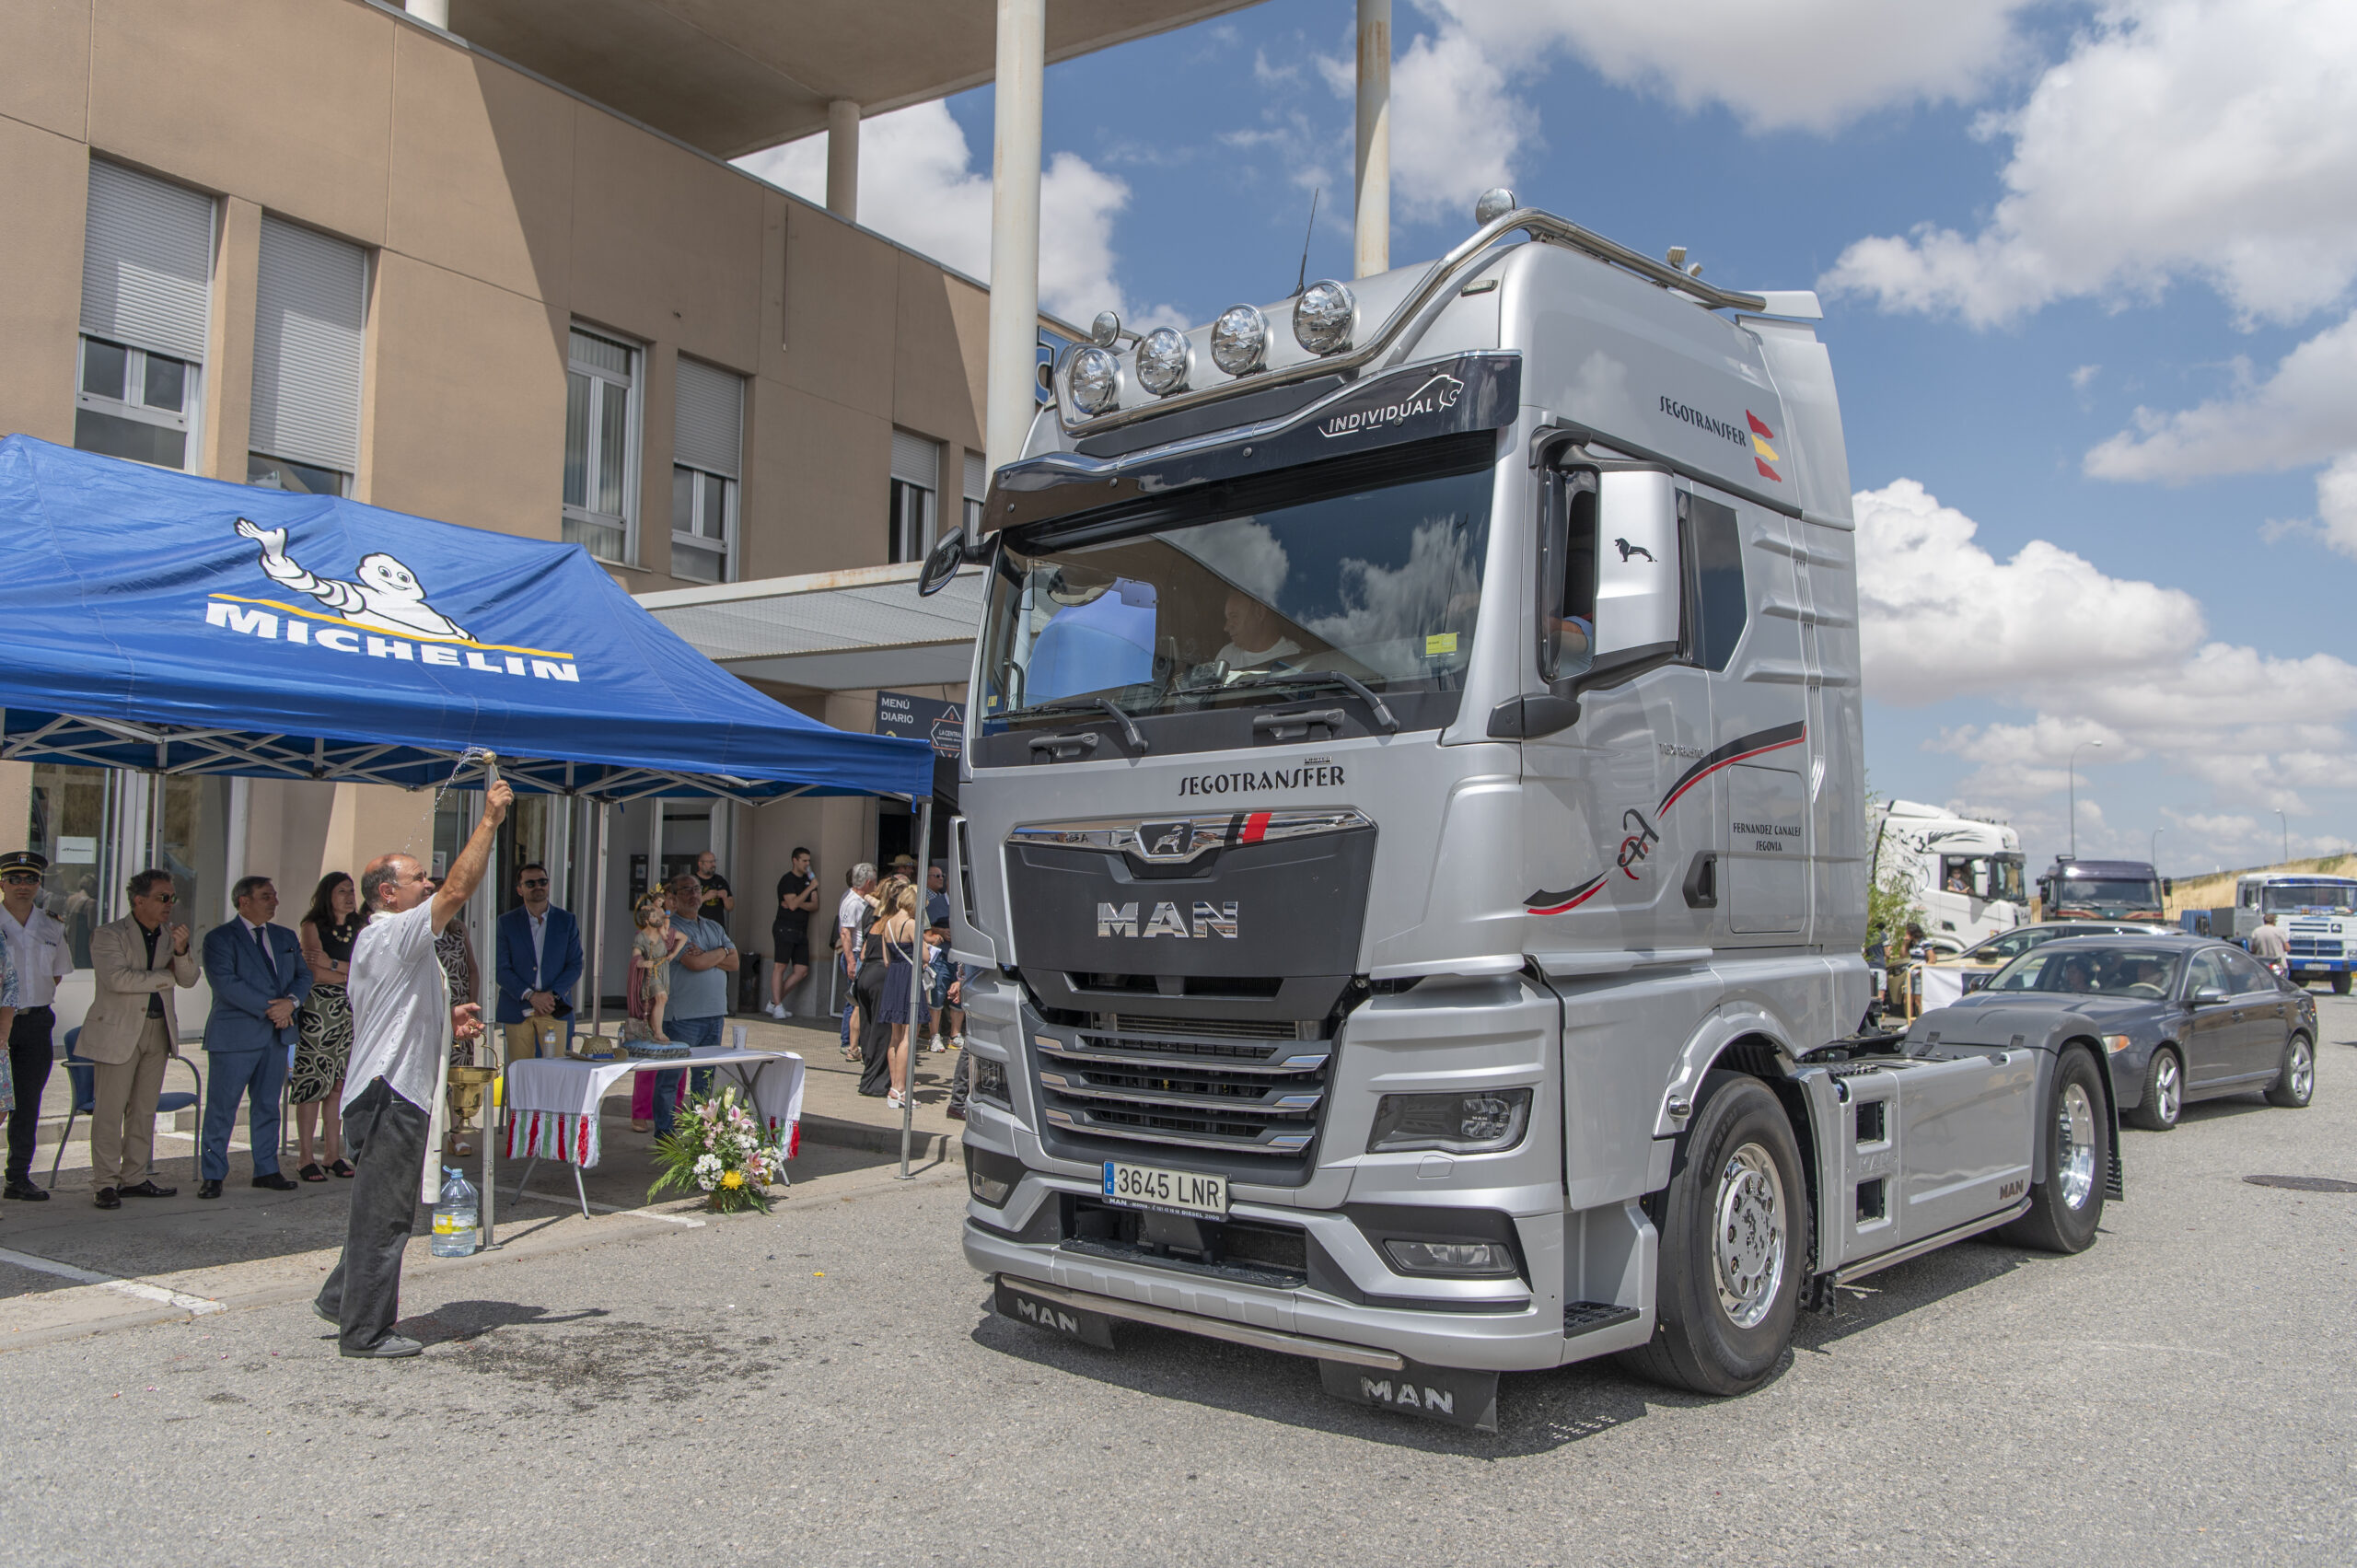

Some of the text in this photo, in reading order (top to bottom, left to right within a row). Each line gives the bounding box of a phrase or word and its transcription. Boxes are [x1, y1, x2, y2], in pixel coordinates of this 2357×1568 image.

[1329, 398, 1434, 434] INDIVIDUAL
[1659, 395, 1747, 447] SEGOTRANSFER
[205, 601, 580, 682] MICHELIN
[880, 712, 914, 725] DIARIO
[881, 697, 911, 710] MENÚ
[1178, 765, 1346, 796] SEGOTRANSFER
[1733, 822, 1802, 837] FERNANDEZ CANALES
[1755, 840, 1782, 852] SEGOVIA
[1097, 901, 1238, 938] MAN
[1107, 1181, 1112, 1190] E
[1119, 1167, 1219, 1208] 3645 LNR
[1999, 1179, 2024, 1200] MAN
[1109, 1198, 1127, 1206] MAN
[1181, 1210, 1203, 1218] DIESEL
[1016, 1297, 1079, 1333] MAN
[1361, 1376, 1454, 1414] MAN
